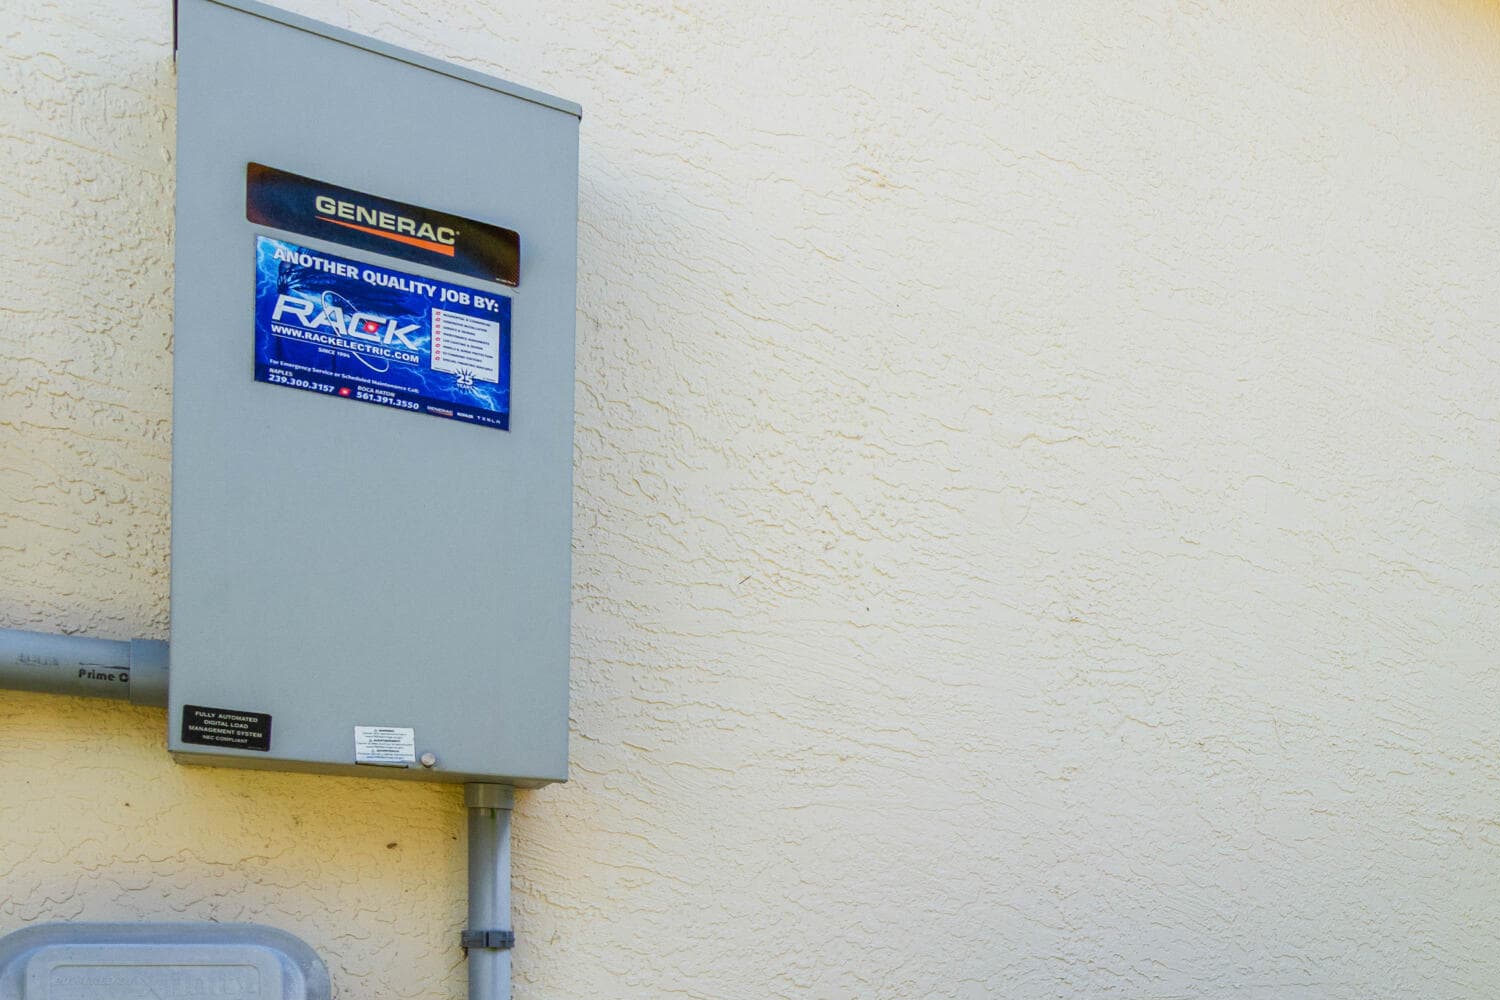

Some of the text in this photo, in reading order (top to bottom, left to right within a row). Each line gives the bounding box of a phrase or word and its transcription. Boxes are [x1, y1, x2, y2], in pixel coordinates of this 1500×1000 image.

[315, 195, 455, 245] GENERAC
[273, 248, 499, 312] ANOTHER QUALITY JOB BY:
[271, 294, 421, 350] RACK
[271, 324, 419, 363] WWW.RACKELECTRIC.COM
[280, 360, 311, 372] Emergency
[268, 374, 335, 393] 239.300.3157
[356, 391, 420, 410] 561.391.3550
[78, 668, 115, 681] Prime
[203, 719, 229, 728] DIGITAL
[218, 714, 259, 723] AUTOMATED
[188, 725, 236, 735] MANAGEMENT
[216, 736, 248, 744] COMPLIANT
